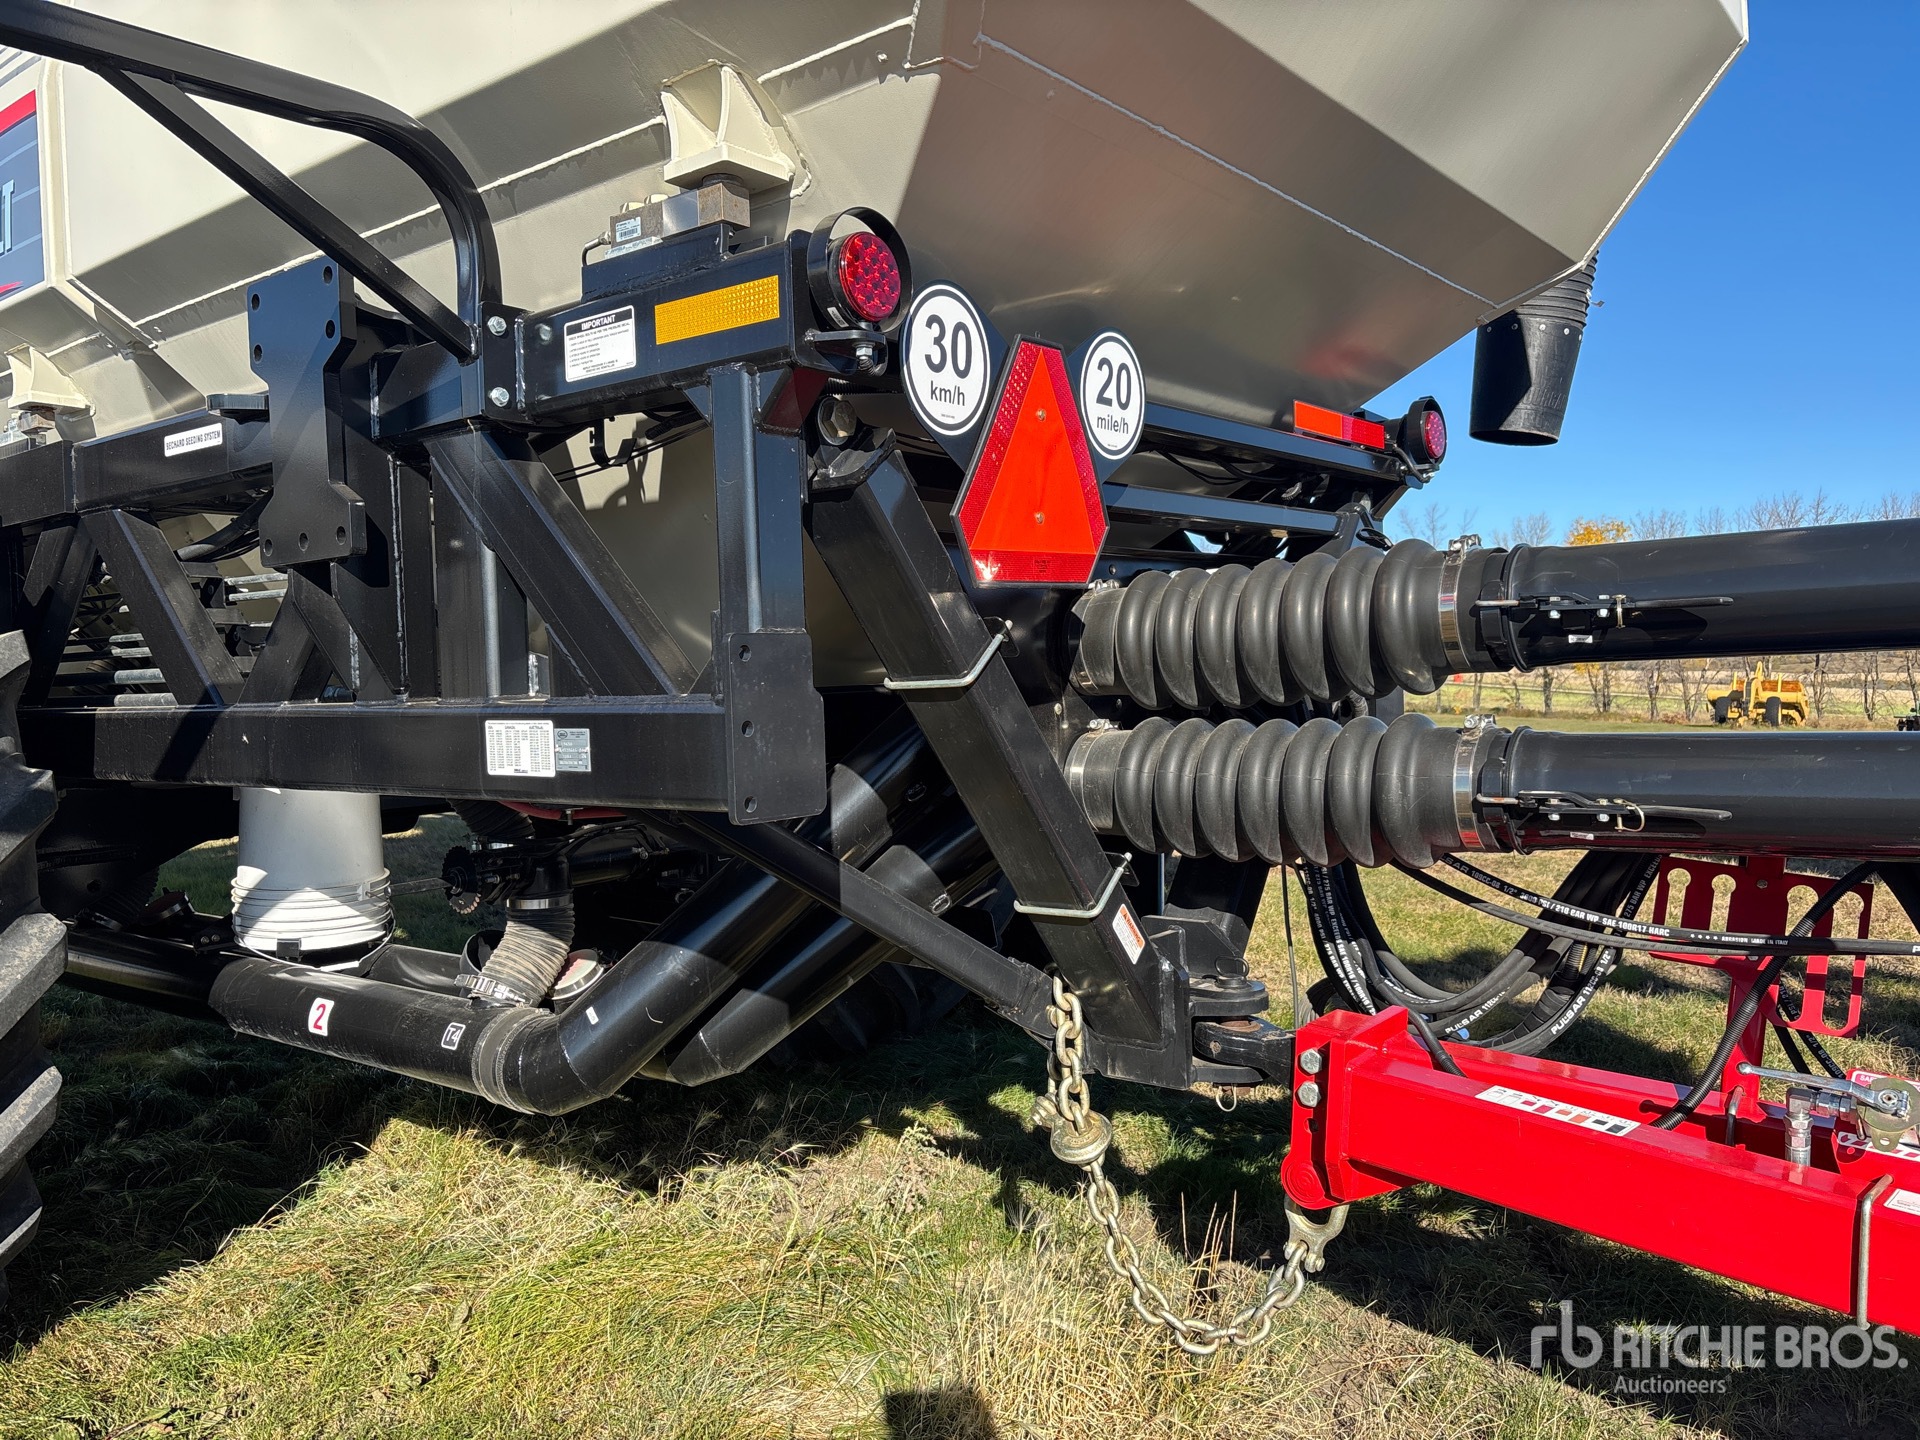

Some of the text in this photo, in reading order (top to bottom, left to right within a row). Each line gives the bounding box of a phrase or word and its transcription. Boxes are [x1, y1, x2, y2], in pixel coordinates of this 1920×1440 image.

[581, 314, 616, 331] IMPORTANT
[924, 313, 973, 380] 30
[930, 380, 965, 407] km/h
[1095, 357, 1132, 411] 20
[186, 433, 203, 446] SEEDING
[204, 429, 221, 442] SYSTEM
[1096, 414, 1129, 435] mile/h
[1555, 904, 1570, 915] 210
[1570, 907, 1585, 920] BAR
[1586, 912, 1599, 923] WP
[1602, 917, 1617, 927] SAE
[1619, 921, 1647, 933] 100R17
[1648, 925, 1670, 937] HARC
[313, 1003, 327, 1031] 2
[1445, 1009, 1483, 1034] PULSAR
[1551, 995, 1586, 1035] PULSAR
[445, 1027, 461, 1043] T4
